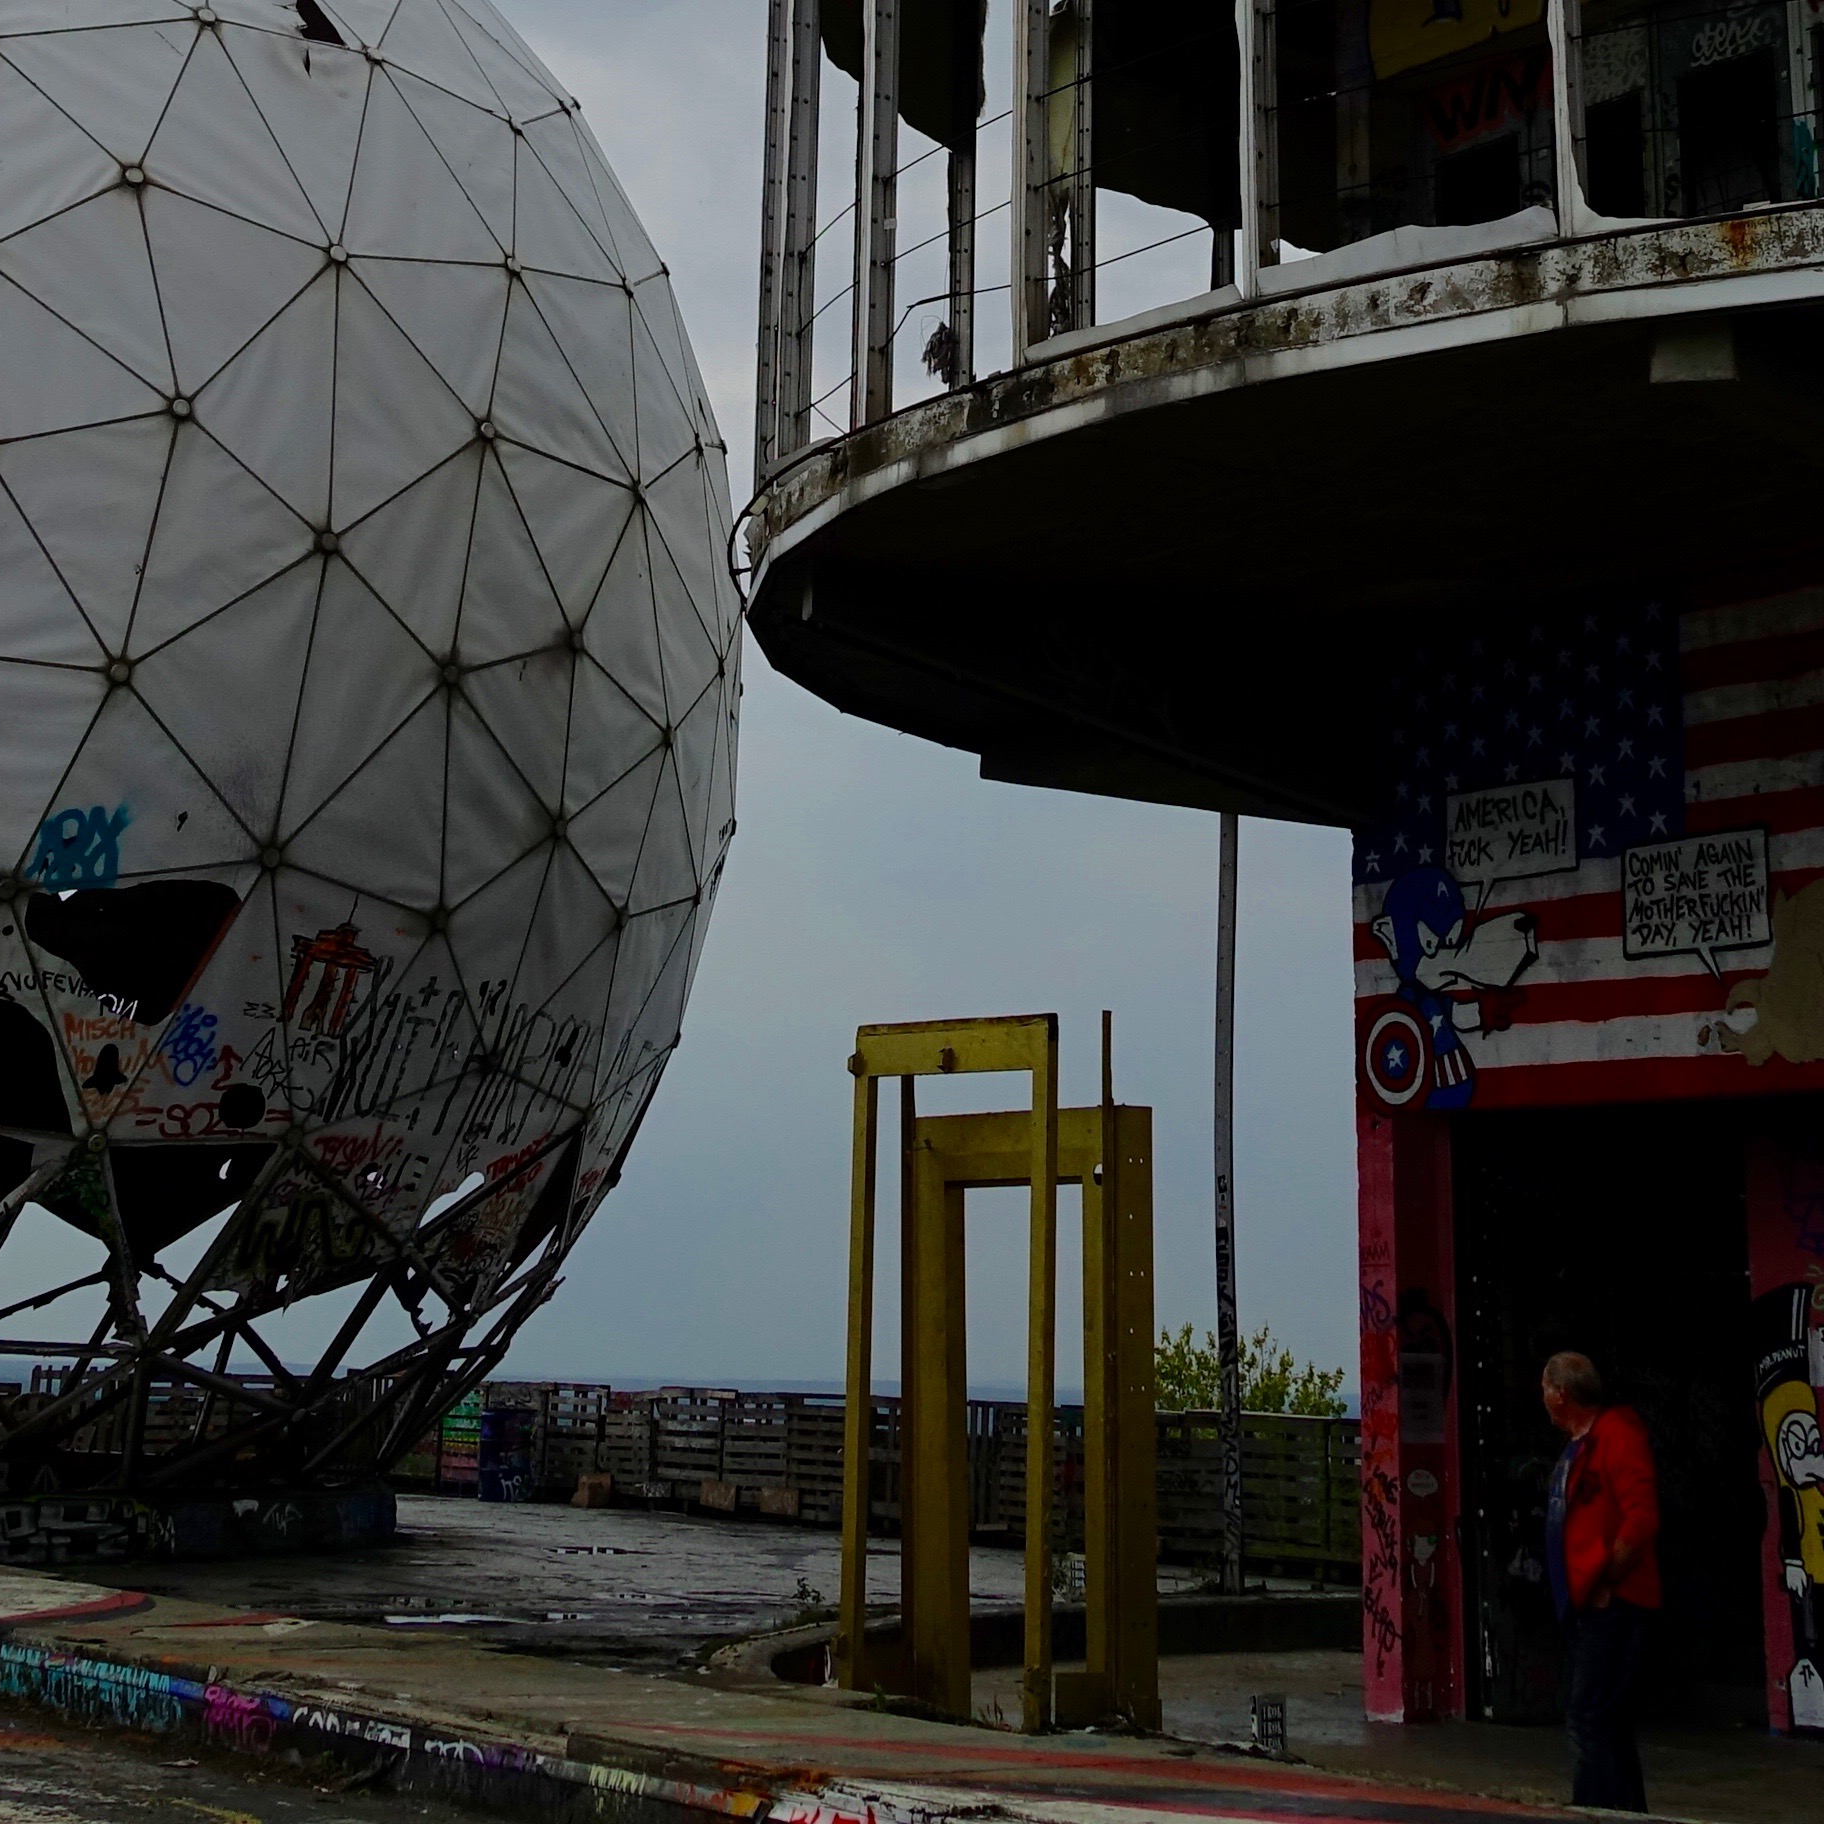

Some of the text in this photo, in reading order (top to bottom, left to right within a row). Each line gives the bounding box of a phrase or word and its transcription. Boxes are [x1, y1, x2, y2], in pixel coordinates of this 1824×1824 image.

[1453, 788, 1567, 833] AMERICA,
[1447, 820, 1567, 869] FUCK YEAH!
[1628, 838, 1754, 878] COMIN' AGAIN
[1627, 863, 1756, 896] TO SAVE THE
[1631, 914, 1753, 947] DAY, YEAH!
